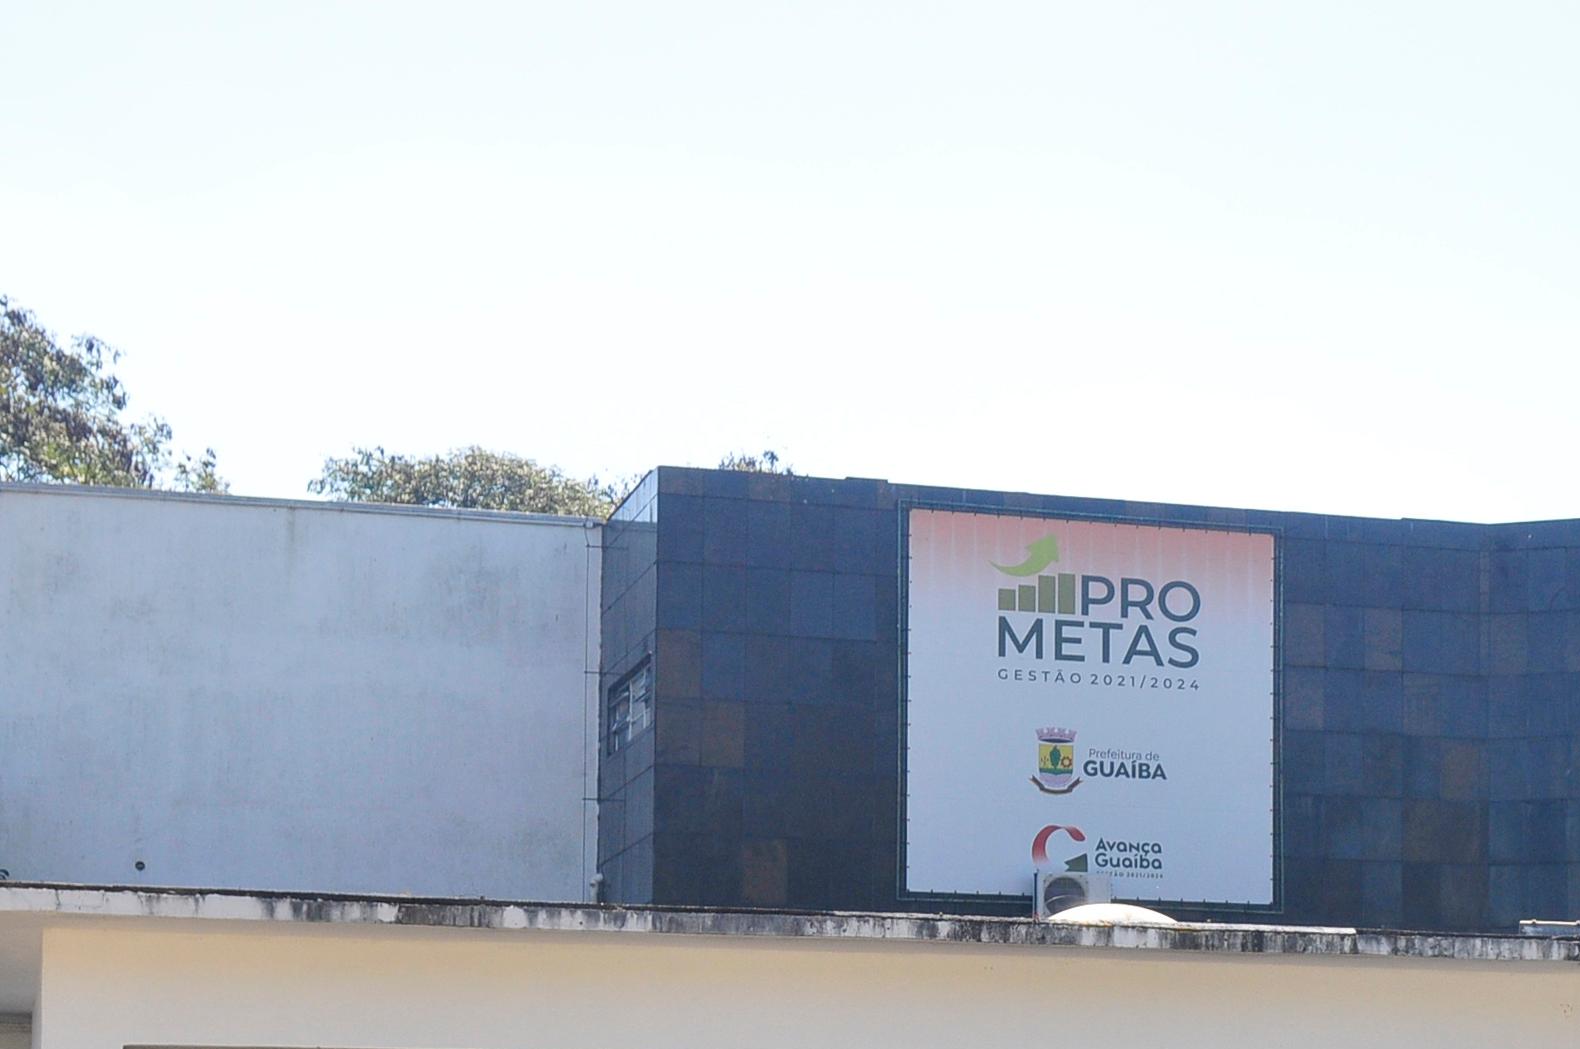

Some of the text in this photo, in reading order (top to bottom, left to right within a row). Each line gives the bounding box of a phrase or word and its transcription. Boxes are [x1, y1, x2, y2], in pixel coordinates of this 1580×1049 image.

[1080, 574, 1201, 622] PRO
[997, 615, 1200, 668] METAS
[997, 668, 1201, 691] GESTÃO 2021/2024
[1088, 748, 1160, 762] Prefeitura de
[1083, 760, 1168, 780] GUAÍBA
[1095, 837, 1162, 857] Avança
[1095, 852, 1162, 870] Guaíba
